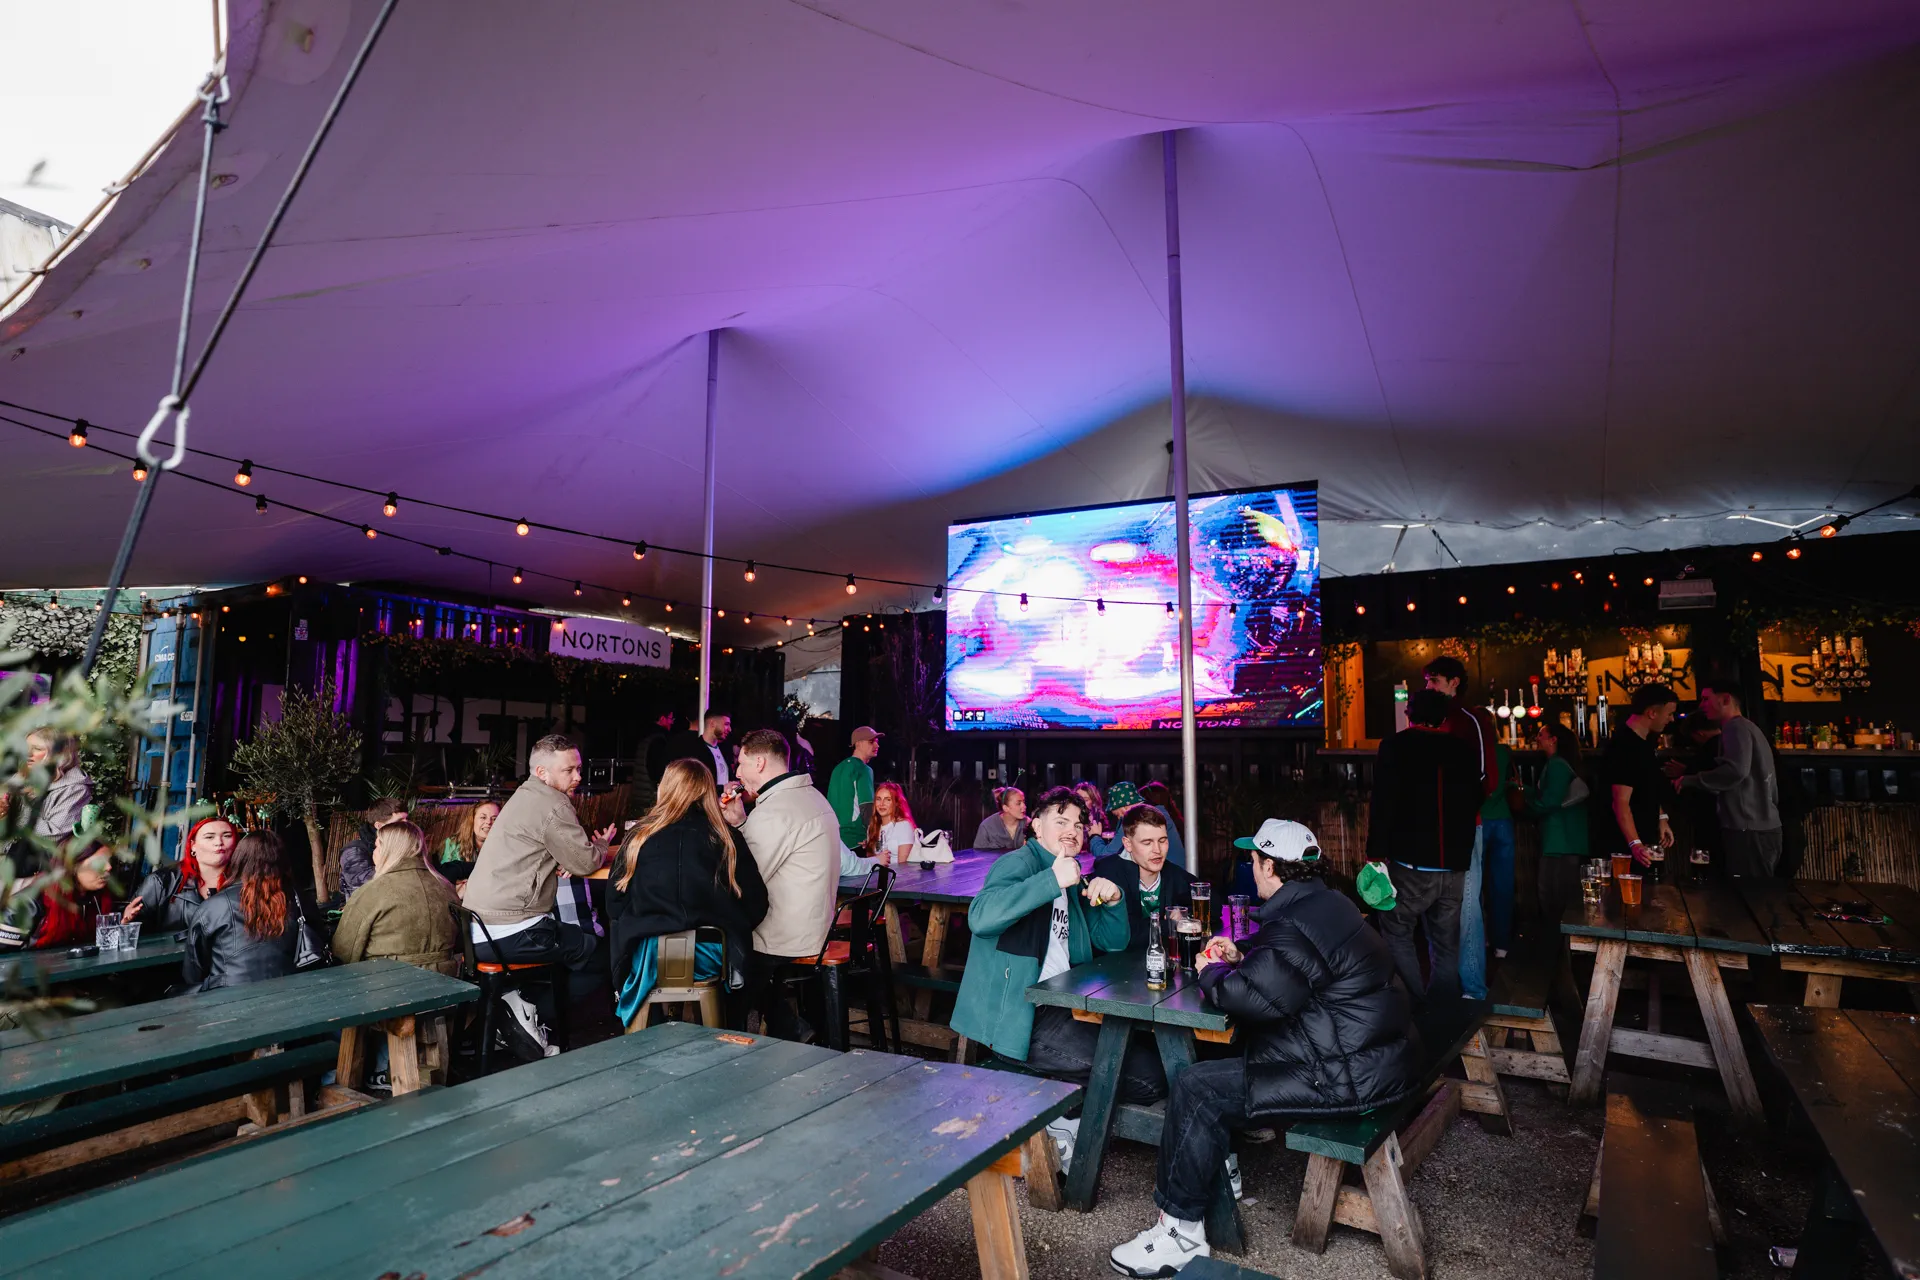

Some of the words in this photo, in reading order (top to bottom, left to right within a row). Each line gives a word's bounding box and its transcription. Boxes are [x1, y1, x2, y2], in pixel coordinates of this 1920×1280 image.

[562, 629, 662, 659] NORTONS
[1024, 720, 1049, 730] PINTS
[1159, 718, 1241, 729] NOTONS
